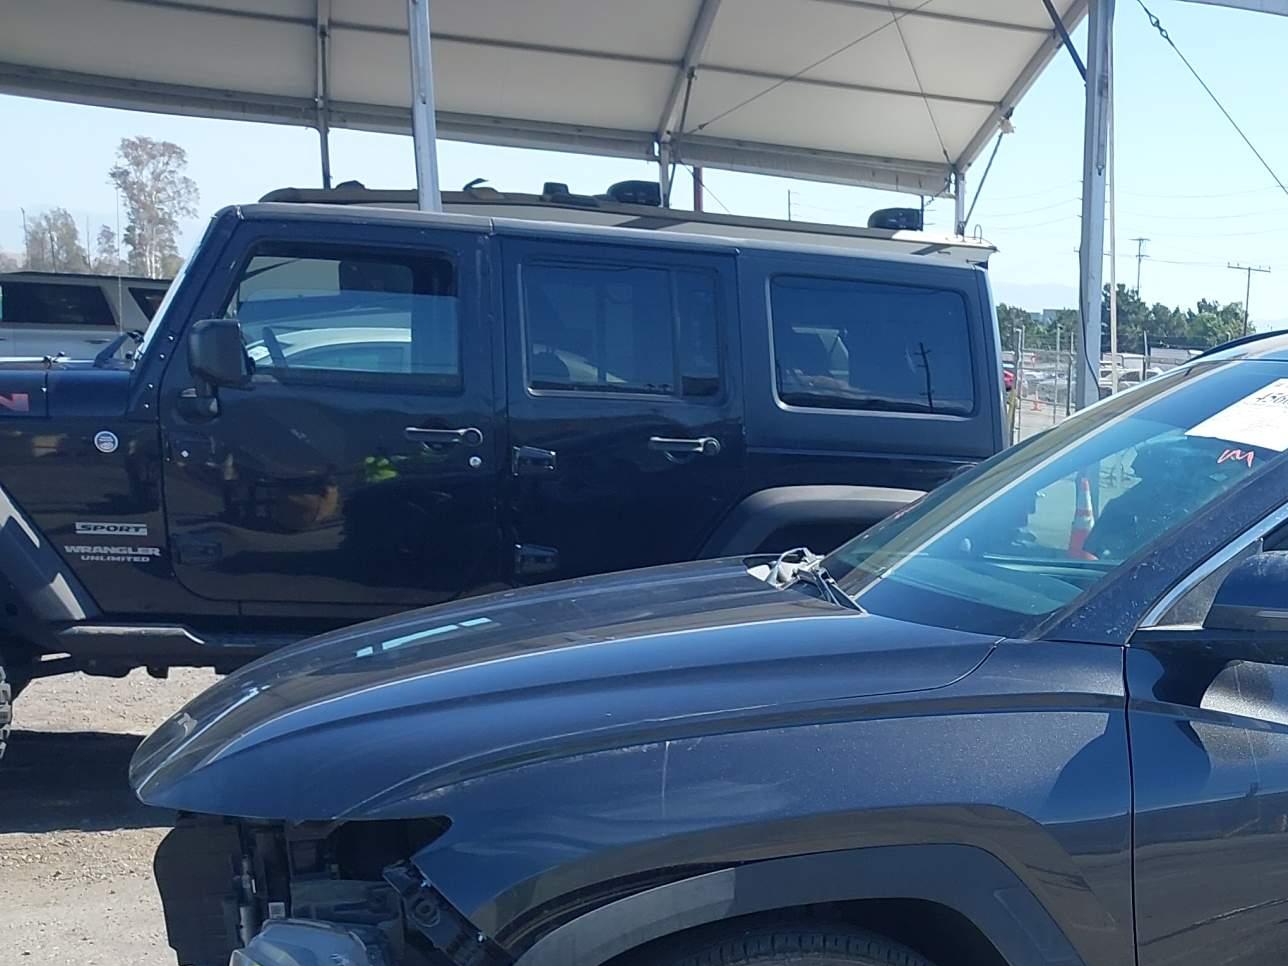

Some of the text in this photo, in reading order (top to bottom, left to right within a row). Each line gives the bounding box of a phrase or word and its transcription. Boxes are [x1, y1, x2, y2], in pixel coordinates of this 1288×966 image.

[79, 523, 143, 534] SPORT
[64, 545, 161, 556] WRANGLER
[80, 555, 150, 563] UNLIMITED
